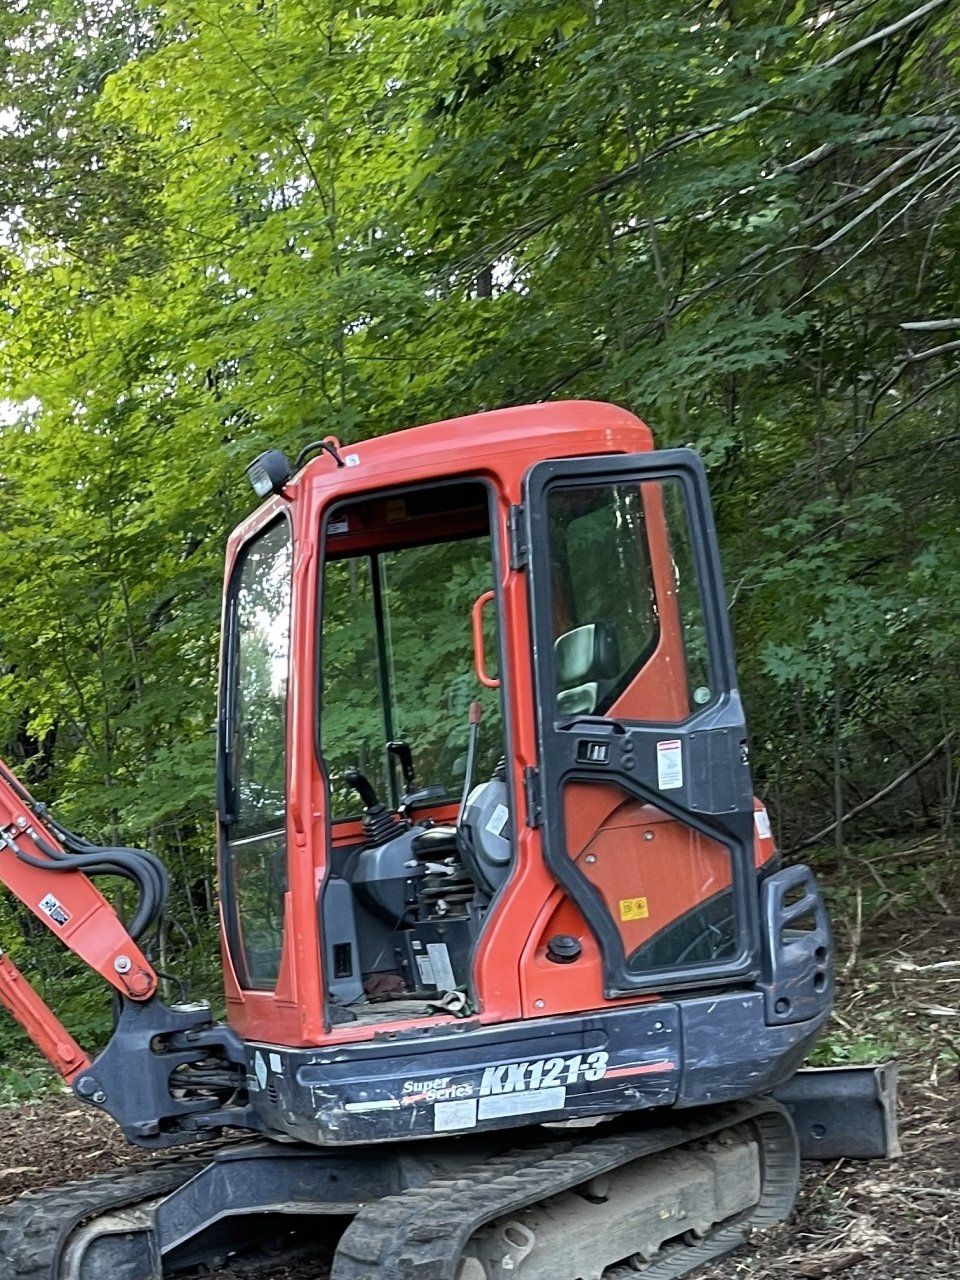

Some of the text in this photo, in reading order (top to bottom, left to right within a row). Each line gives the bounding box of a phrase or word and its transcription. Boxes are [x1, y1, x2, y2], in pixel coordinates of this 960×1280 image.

[479, 1051, 610, 1096] KX121-3
[402, 1076, 453, 1095] Super
[426, 1080, 474, 1101] Series
